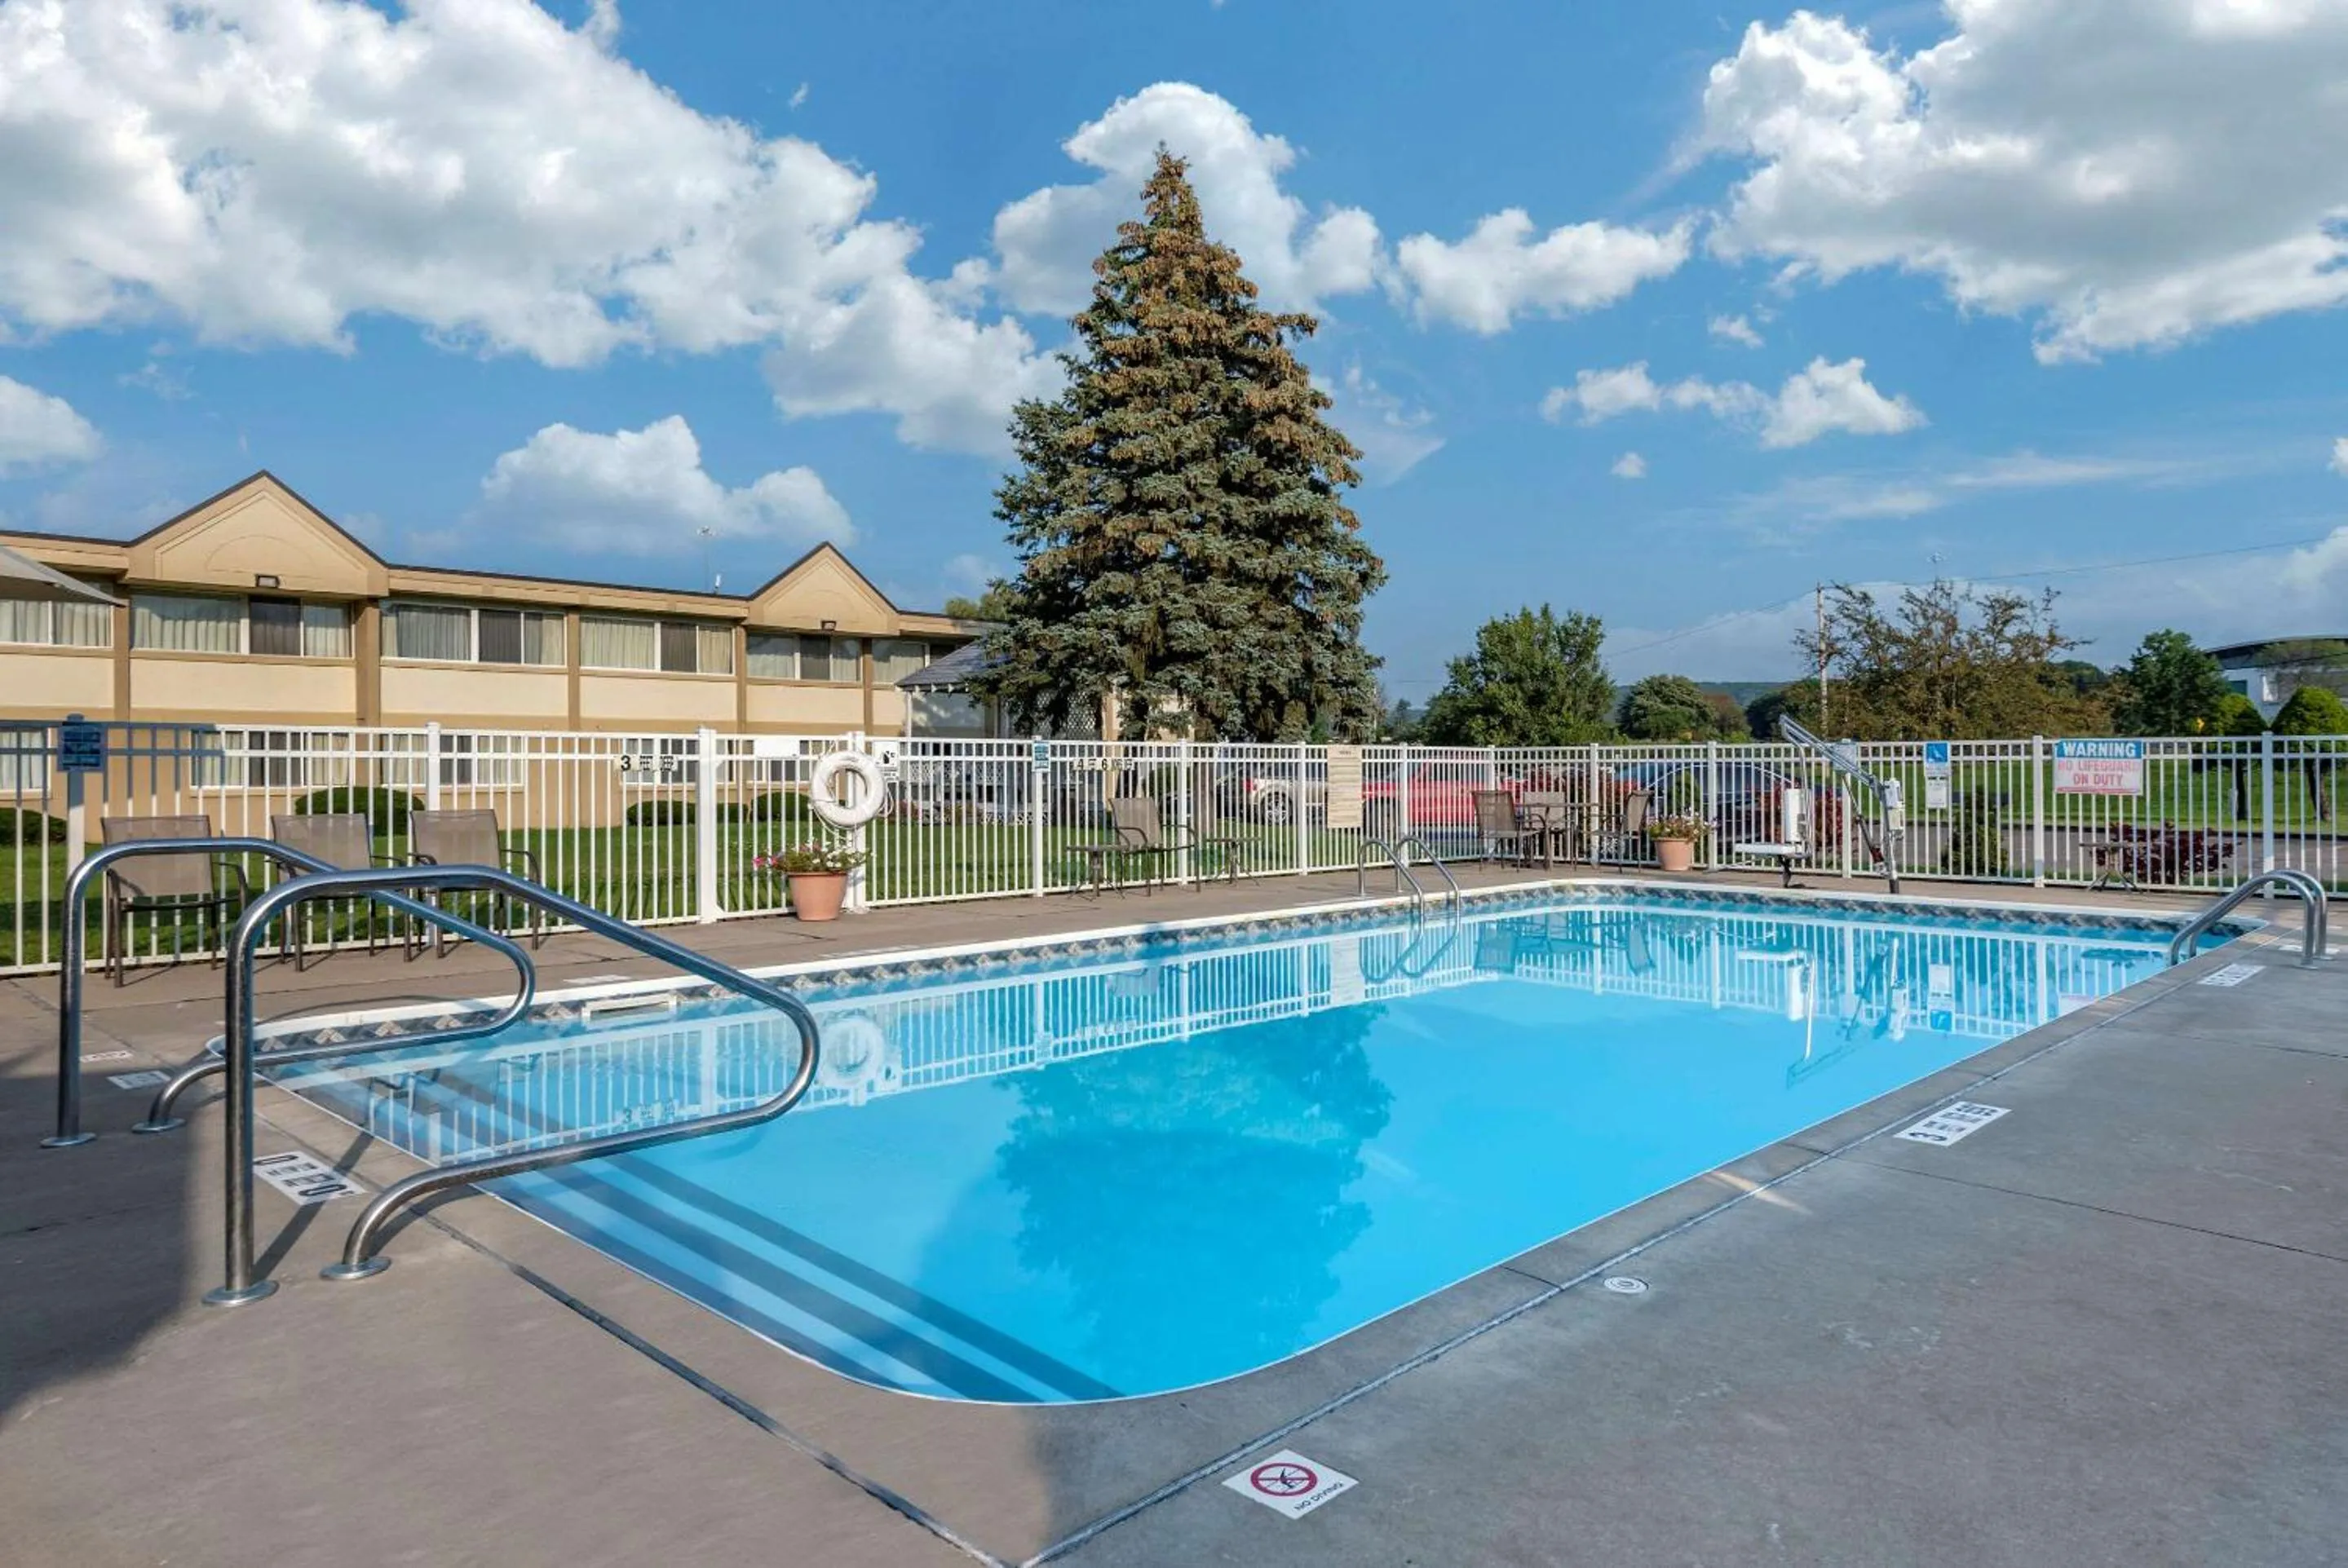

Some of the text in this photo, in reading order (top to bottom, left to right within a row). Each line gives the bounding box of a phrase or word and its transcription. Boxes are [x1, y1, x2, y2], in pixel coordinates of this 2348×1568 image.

[2063, 741, 2137, 757] WARNING
[621, 754, 632, 771] 3
[2072, 773, 2124, 786] ON DUTY
